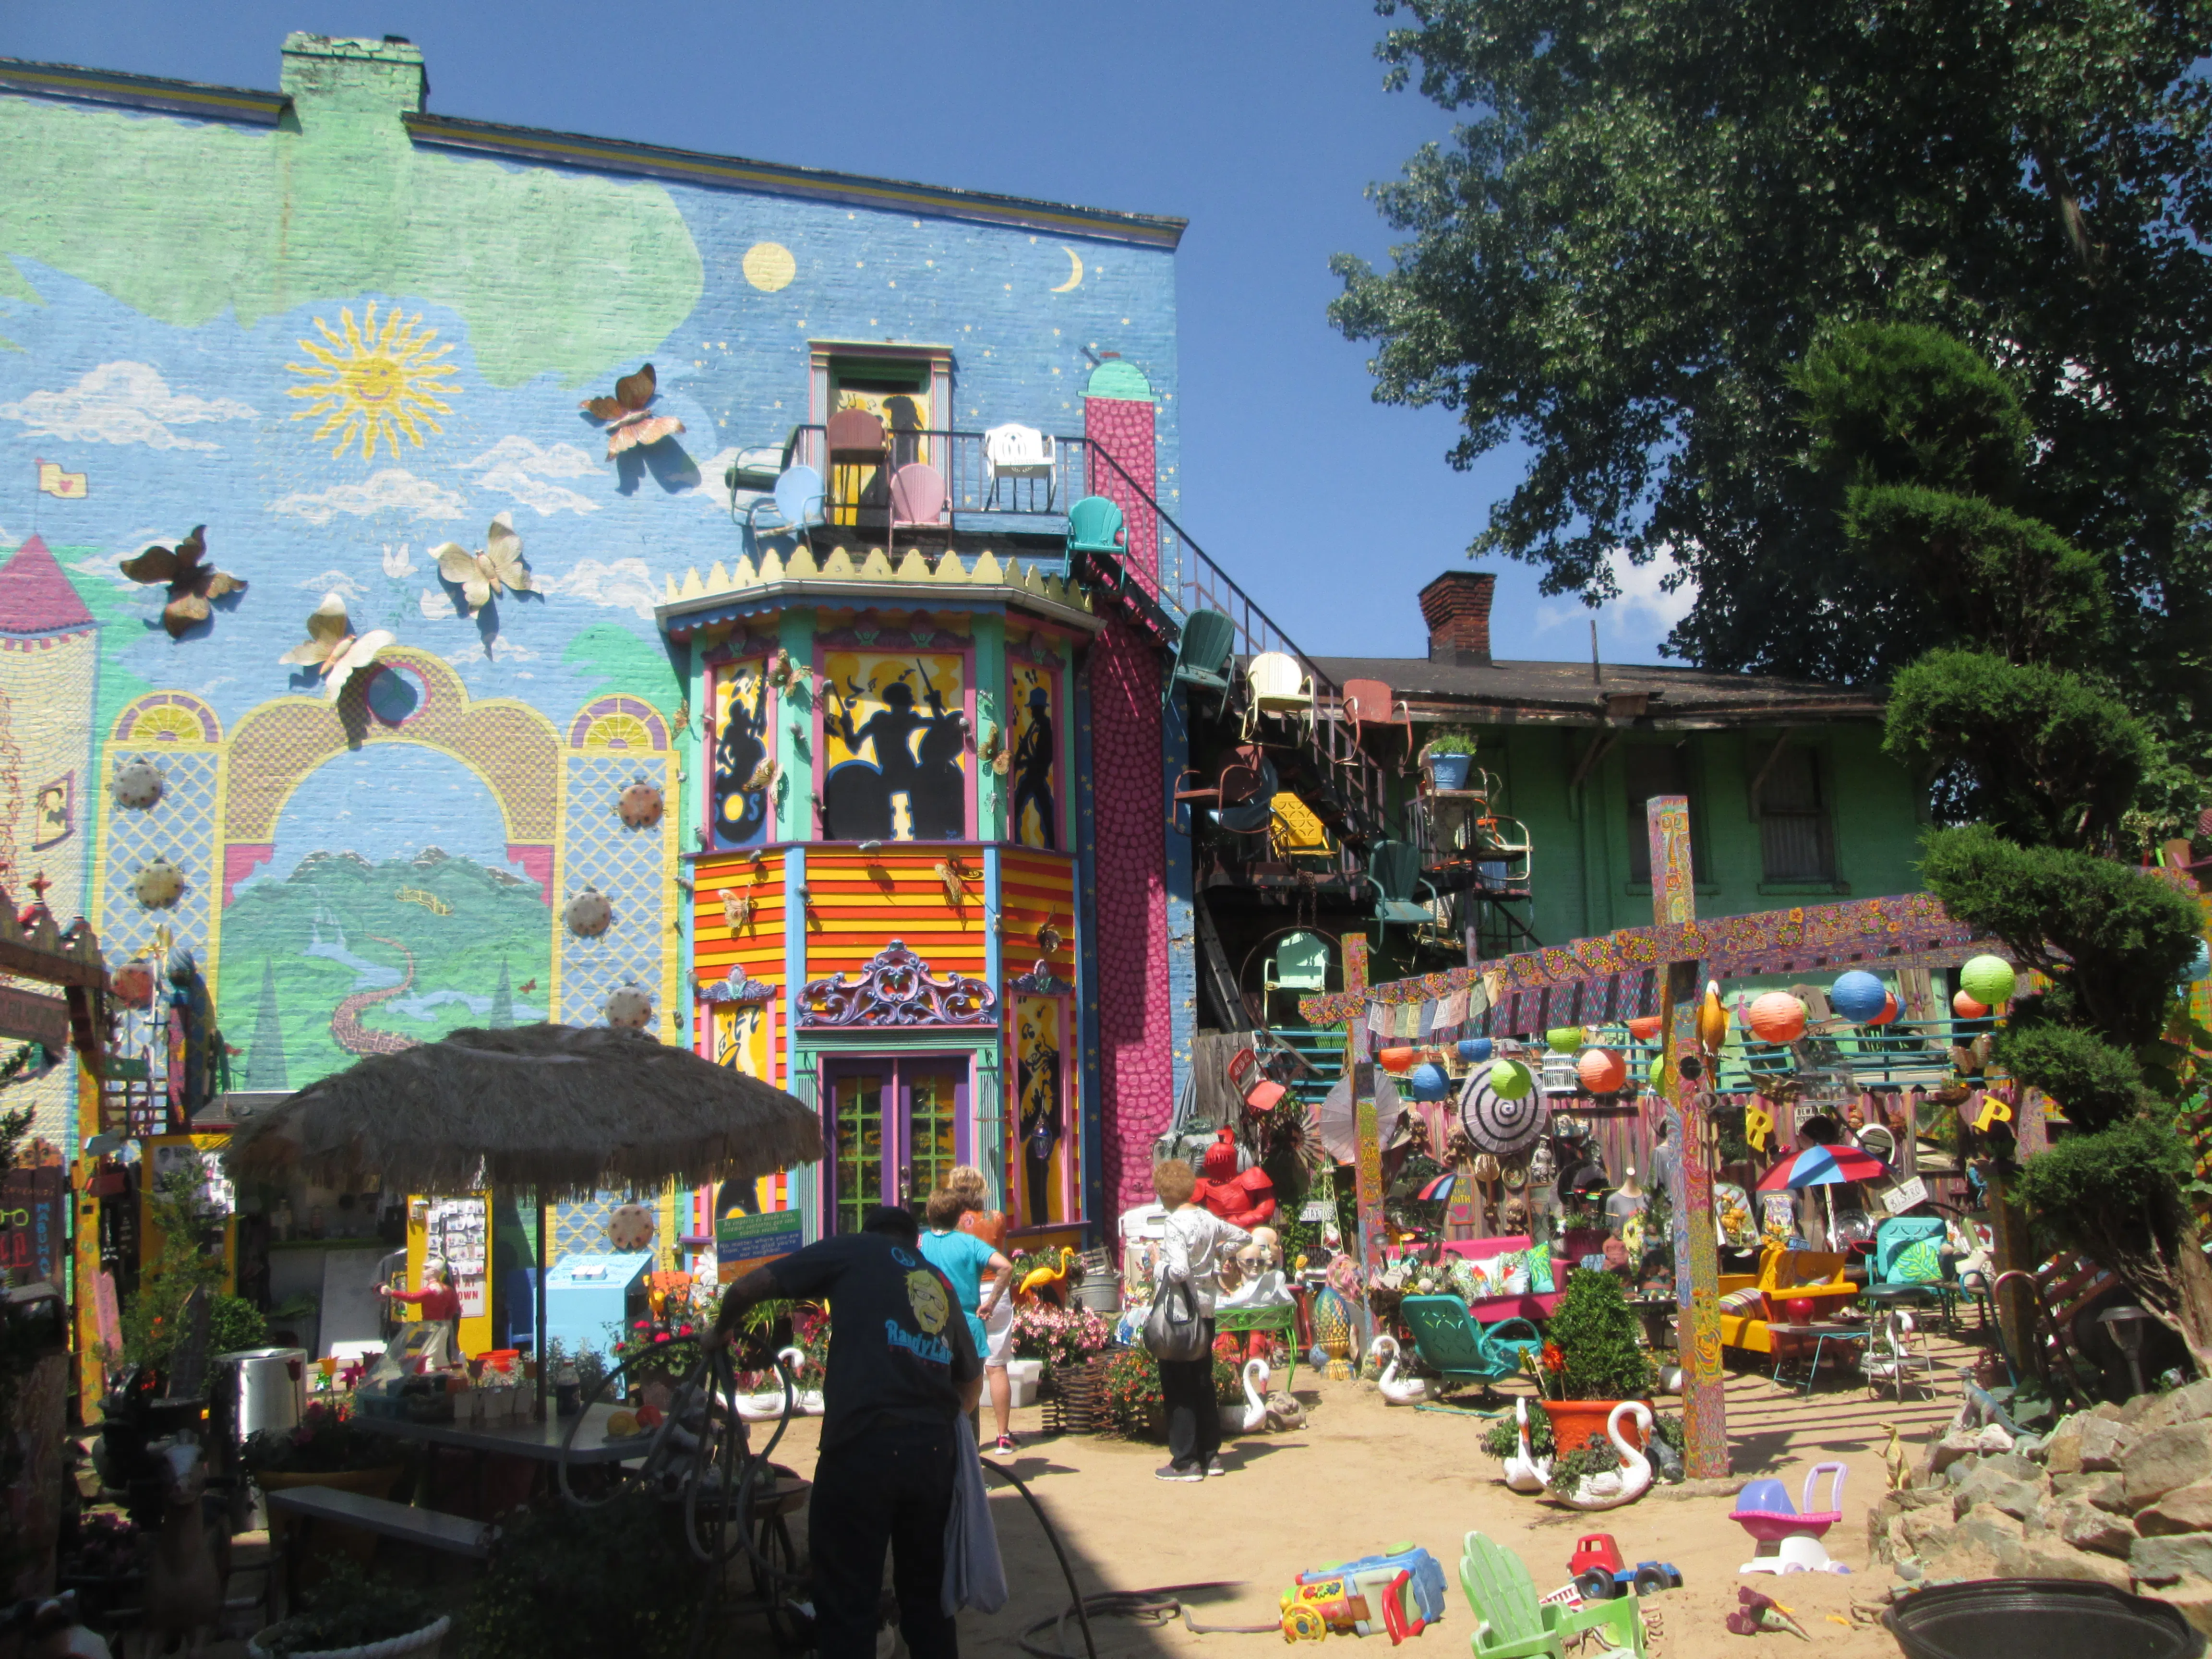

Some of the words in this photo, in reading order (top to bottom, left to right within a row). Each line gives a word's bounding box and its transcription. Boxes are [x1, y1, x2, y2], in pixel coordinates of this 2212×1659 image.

[1971, 1095, 2011, 1132] P
[1746, 1105, 1773, 1152] R
[1451, 1194, 1471, 1203] FAITH
[465, 1278, 476, 1287] AT
[457, 1290, 478, 1300] OWN
